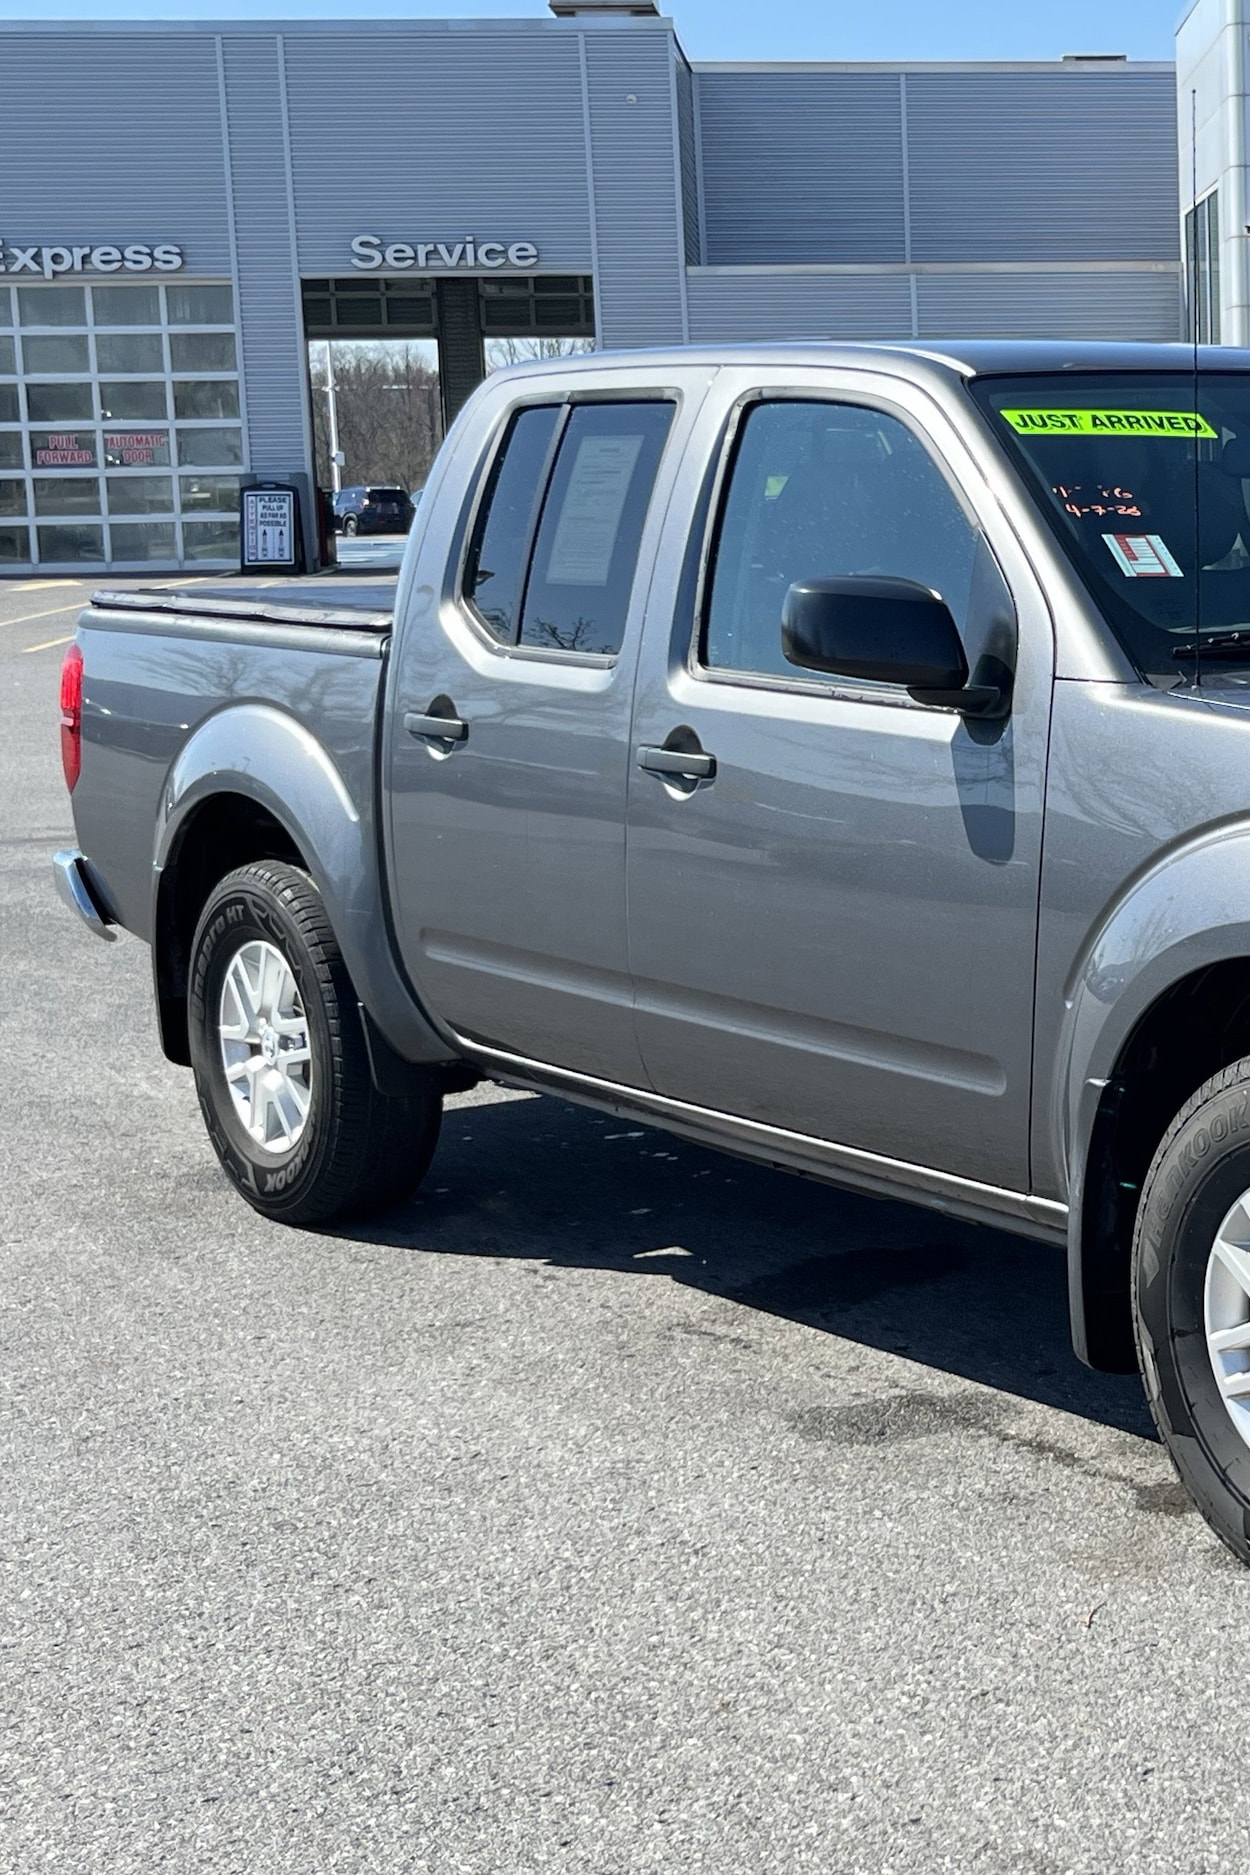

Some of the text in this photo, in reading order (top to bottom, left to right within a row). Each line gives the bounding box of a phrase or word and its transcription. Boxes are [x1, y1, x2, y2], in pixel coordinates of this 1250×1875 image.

[0, 239, 183, 279] xpress
[350, 235, 538, 269] Service
[1014, 414, 1204, 431] JUST ARRIVED
[48, 435, 78, 449] PULL
[108, 435, 166, 448] AUTOMATIC
[37, 450, 92, 464] FORWARD
[123, 450, 153, 463] DOOR
[226, 904, 244, 924] HT
